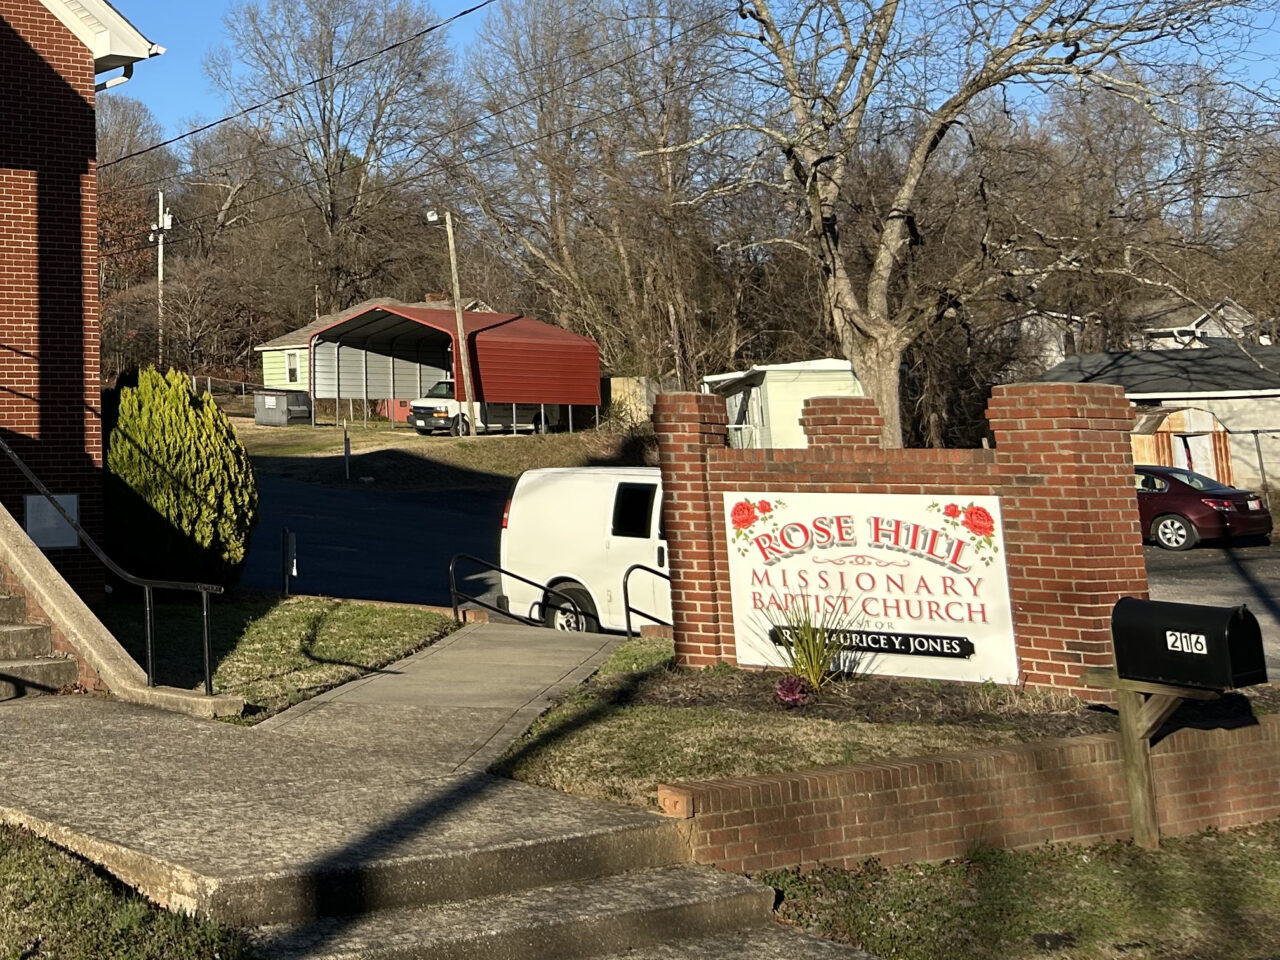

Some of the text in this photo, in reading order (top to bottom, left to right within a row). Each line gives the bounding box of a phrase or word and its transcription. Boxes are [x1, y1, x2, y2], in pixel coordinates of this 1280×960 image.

[752, 515, 971, 574] ROSE HILL
[751, 568, 983, 597] MISSIONARY
[751, 591, 987, 623] BAPTIST CHURCH
[890, 635, 905, 650] Y.
[909, 637, 961, 654] JONES
[1169, 632, 1204, 652] 216
